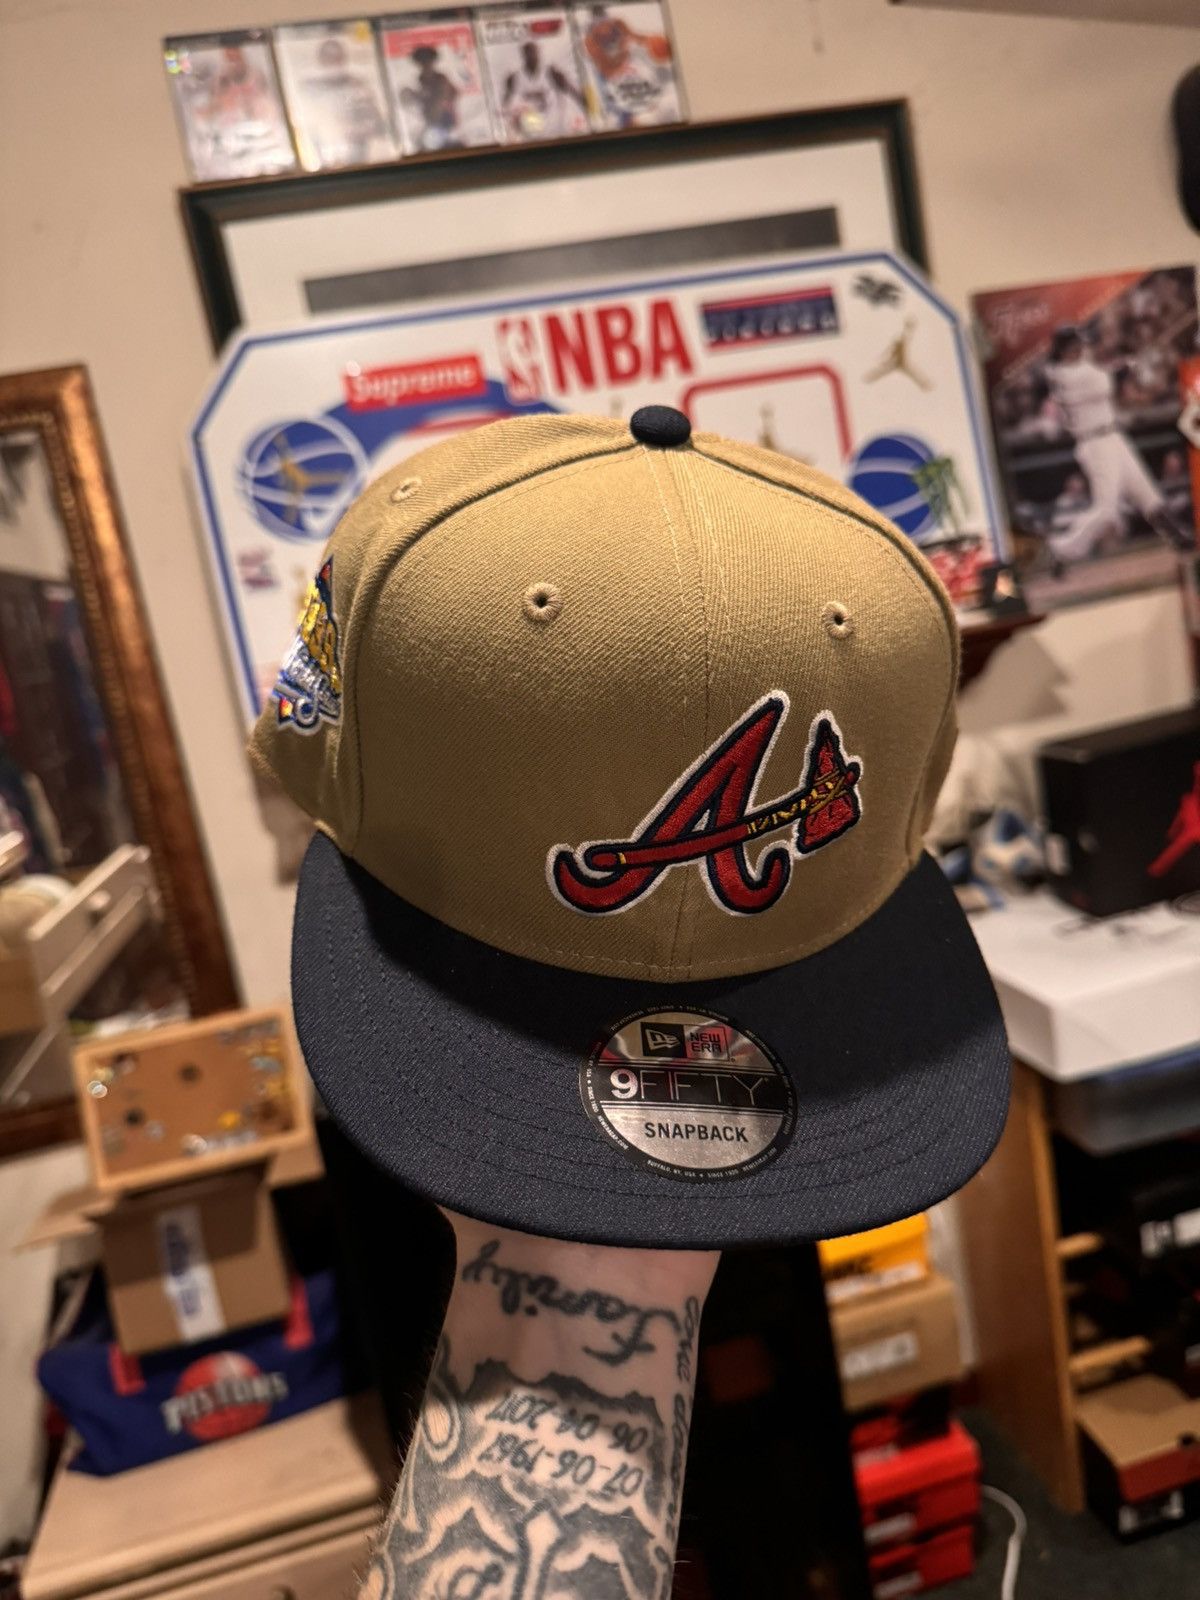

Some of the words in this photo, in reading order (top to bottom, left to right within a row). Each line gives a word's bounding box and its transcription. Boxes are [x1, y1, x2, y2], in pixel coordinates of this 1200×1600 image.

[543, 298, 692, 393] NBA
[354, 362, 473, 407] Supreme
[690, 1032, 720, 1043] NEW
[691, 1042, 722, 1053] ERA
[610, 1068, 763, 1106] 9FIFTY
[644, 1122, 749, 1143] SNAPBACK
[463, 1239, 682, 1367] Family
